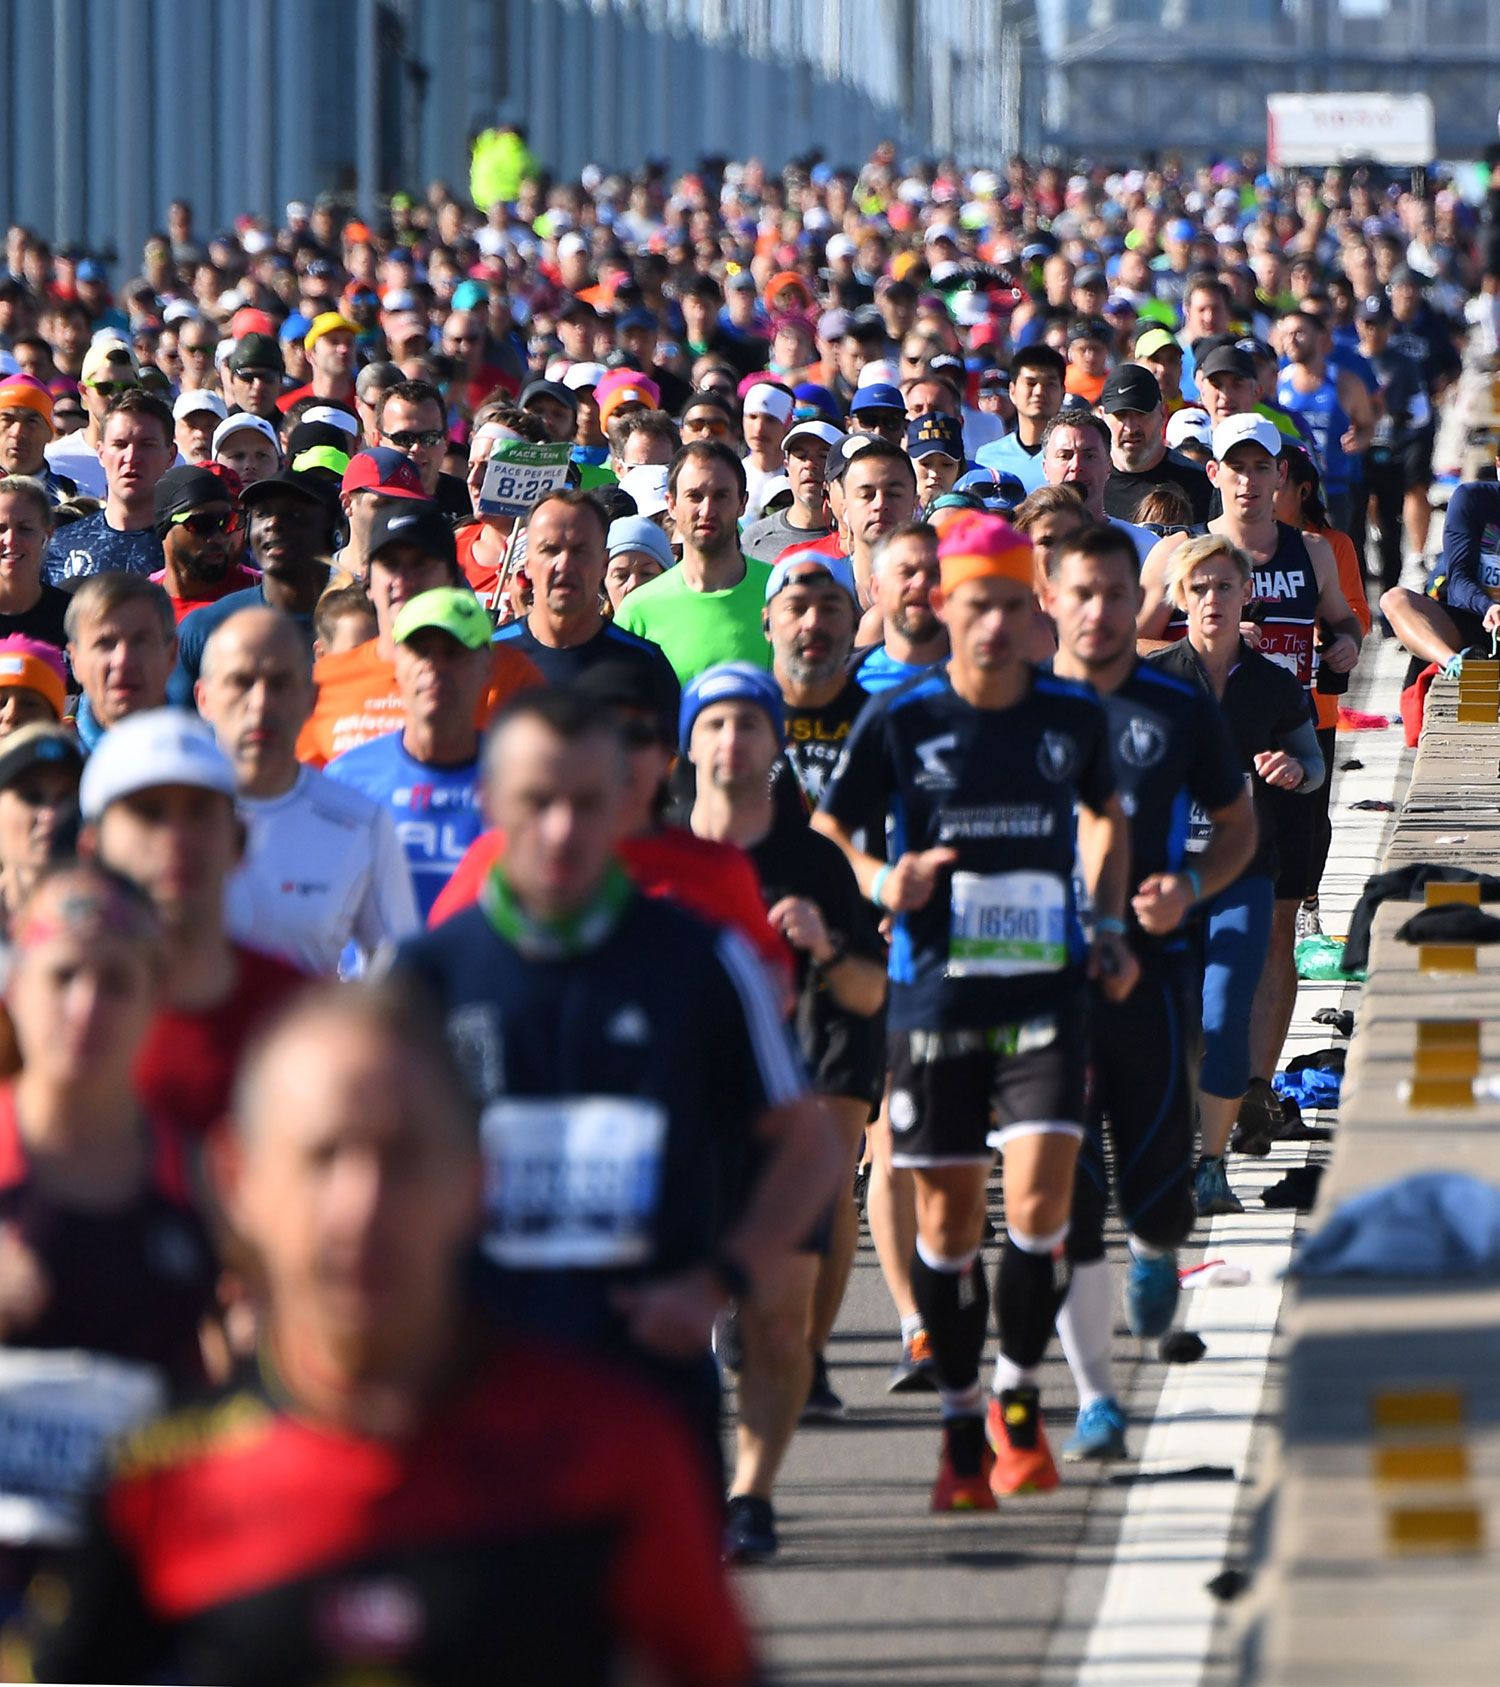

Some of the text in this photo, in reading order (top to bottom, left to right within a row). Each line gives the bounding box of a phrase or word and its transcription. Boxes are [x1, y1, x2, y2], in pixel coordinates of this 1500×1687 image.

[508, 450, 537, 459] PACE
[494, 465, 562, 479] PACE PER MILE
[1251, 571, 1305, 598] HAP
[1259, 634, 1307, 652] or The
[804, 745, 837, 761] TCS
